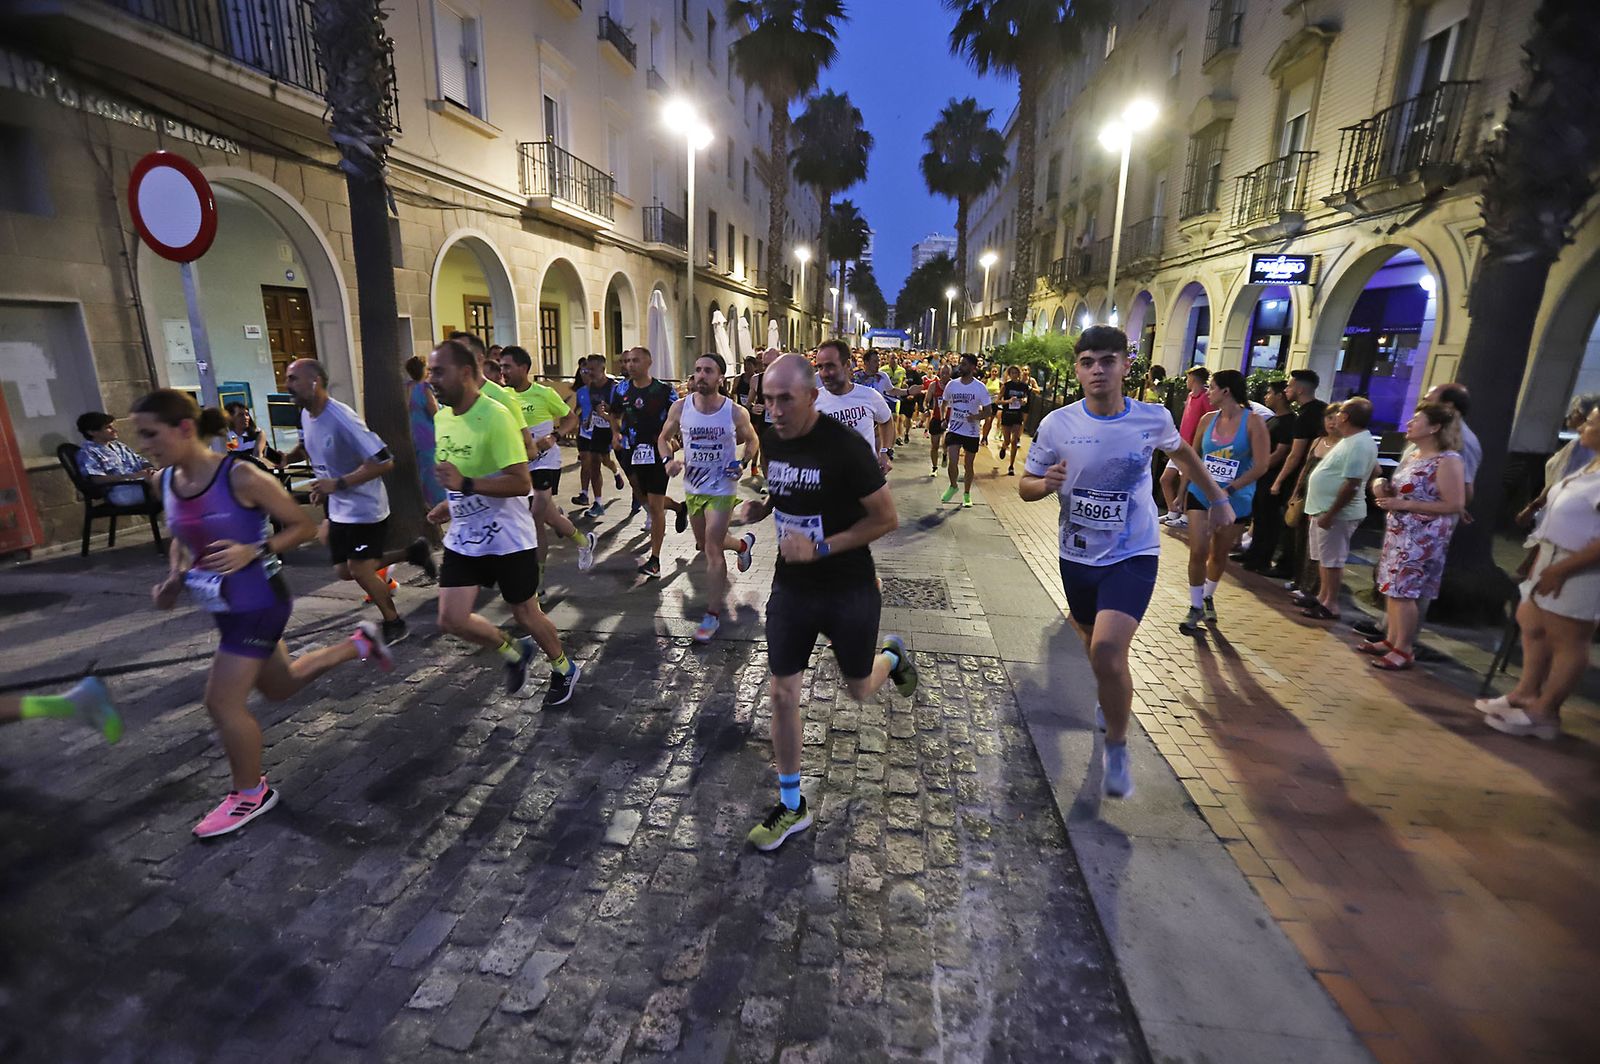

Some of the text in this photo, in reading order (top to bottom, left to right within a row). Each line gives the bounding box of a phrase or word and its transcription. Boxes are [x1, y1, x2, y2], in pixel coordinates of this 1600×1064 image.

[698, 451, 714, 462] 379
[800, 468, 821, 485] FUN
[1210, 464, 1227, 476] 549
[1084, 502, 1111, 519] 696
